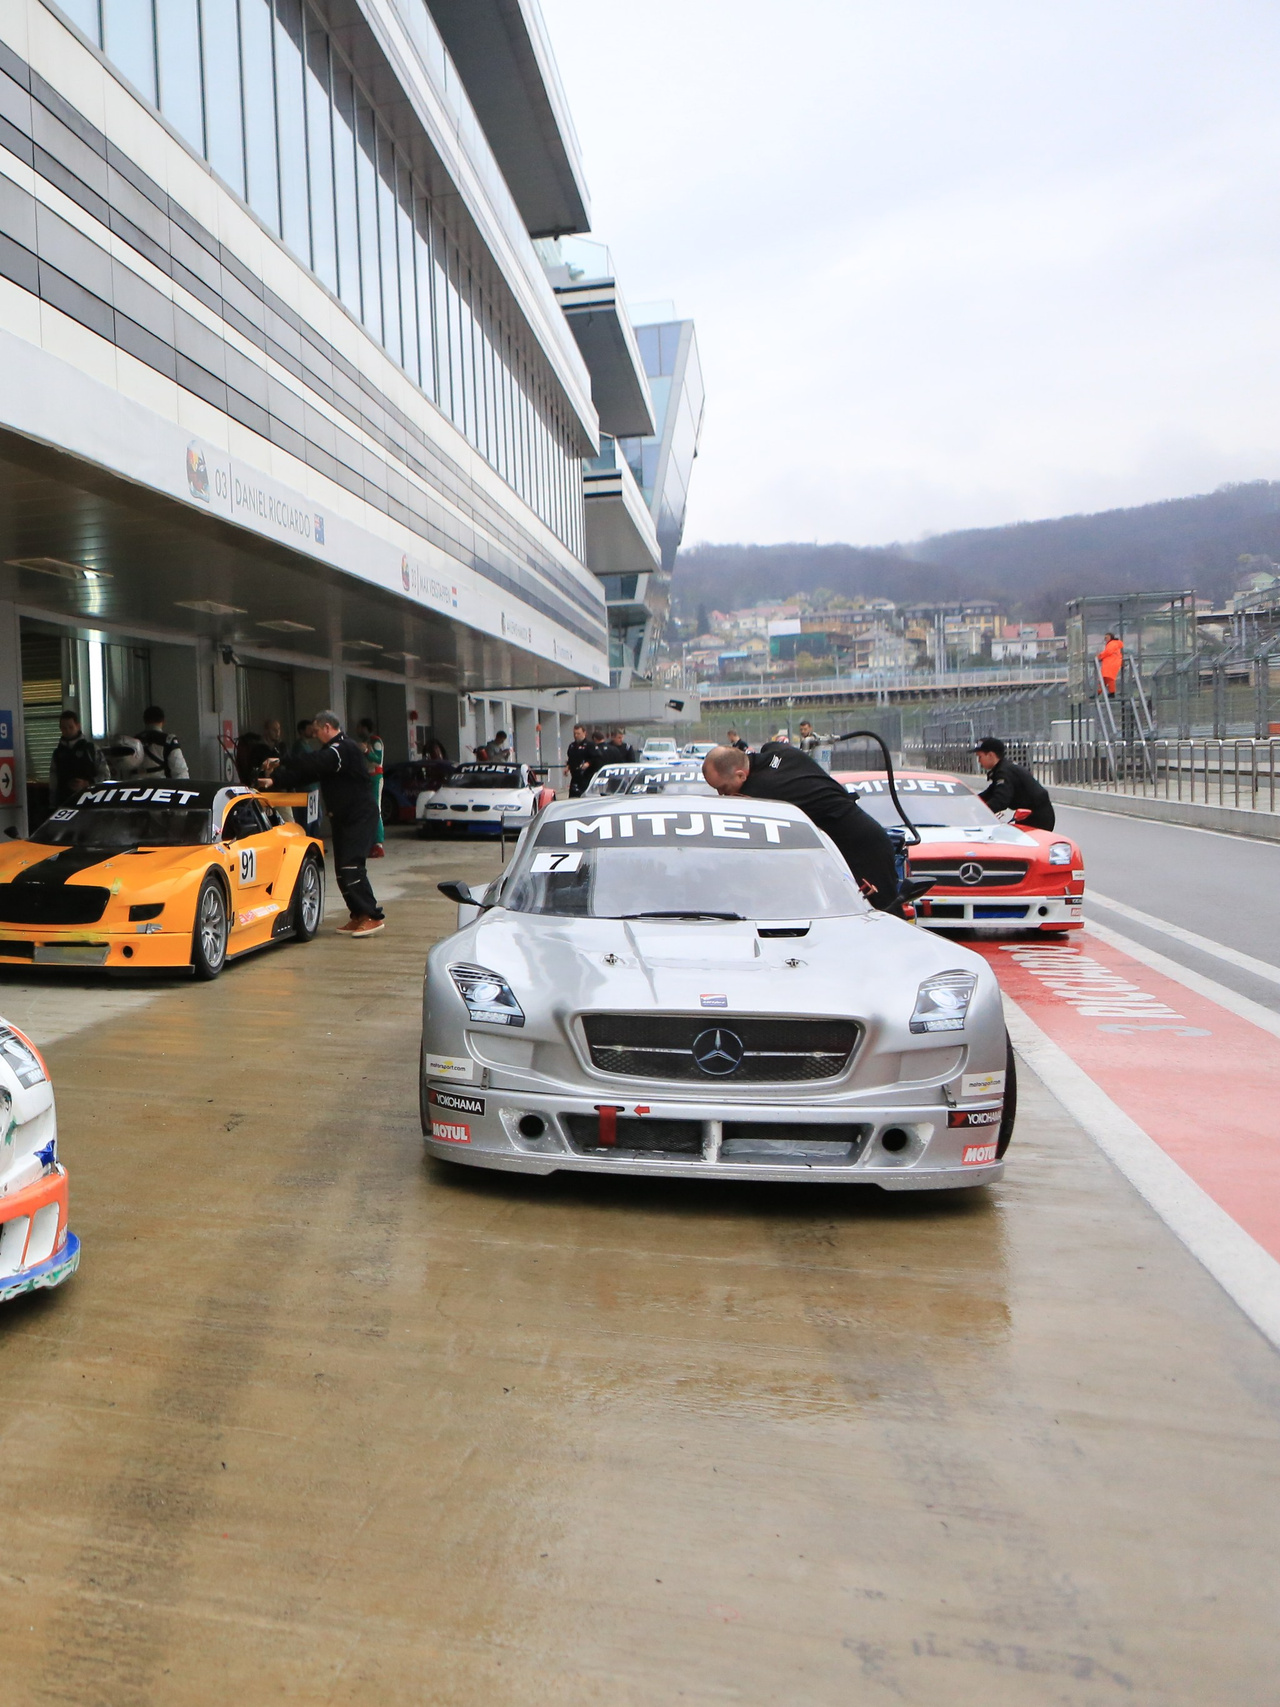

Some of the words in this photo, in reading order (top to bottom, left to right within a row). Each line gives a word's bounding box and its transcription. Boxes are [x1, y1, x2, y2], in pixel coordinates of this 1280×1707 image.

[214, 468, 228, 499] 03
[235, 478, 268, 520] DANIEL
[269, 495, 311, 538] RICCIARDO
[0, 722, 8, 739] 9
[461, 764, 517, 774] MITJET
[644, 772, 707, 784] MITJE
[844, 779, 957, 794] MITJET
[76, 788, 200, 805] MITJET
[309, 794, 317, 816] 91
[54, 809, 75, 820] 91
[564, 813, 791, 845] MITJET
[241, 849, 254, 880] 91
[548, 854, 570, 870] 7
[430, 1061, 466, 1072] motorsport.com
[436, 1093, 482, 1113] YOKOHAMA
[432, 1122, 468, 1141] MOTUL
